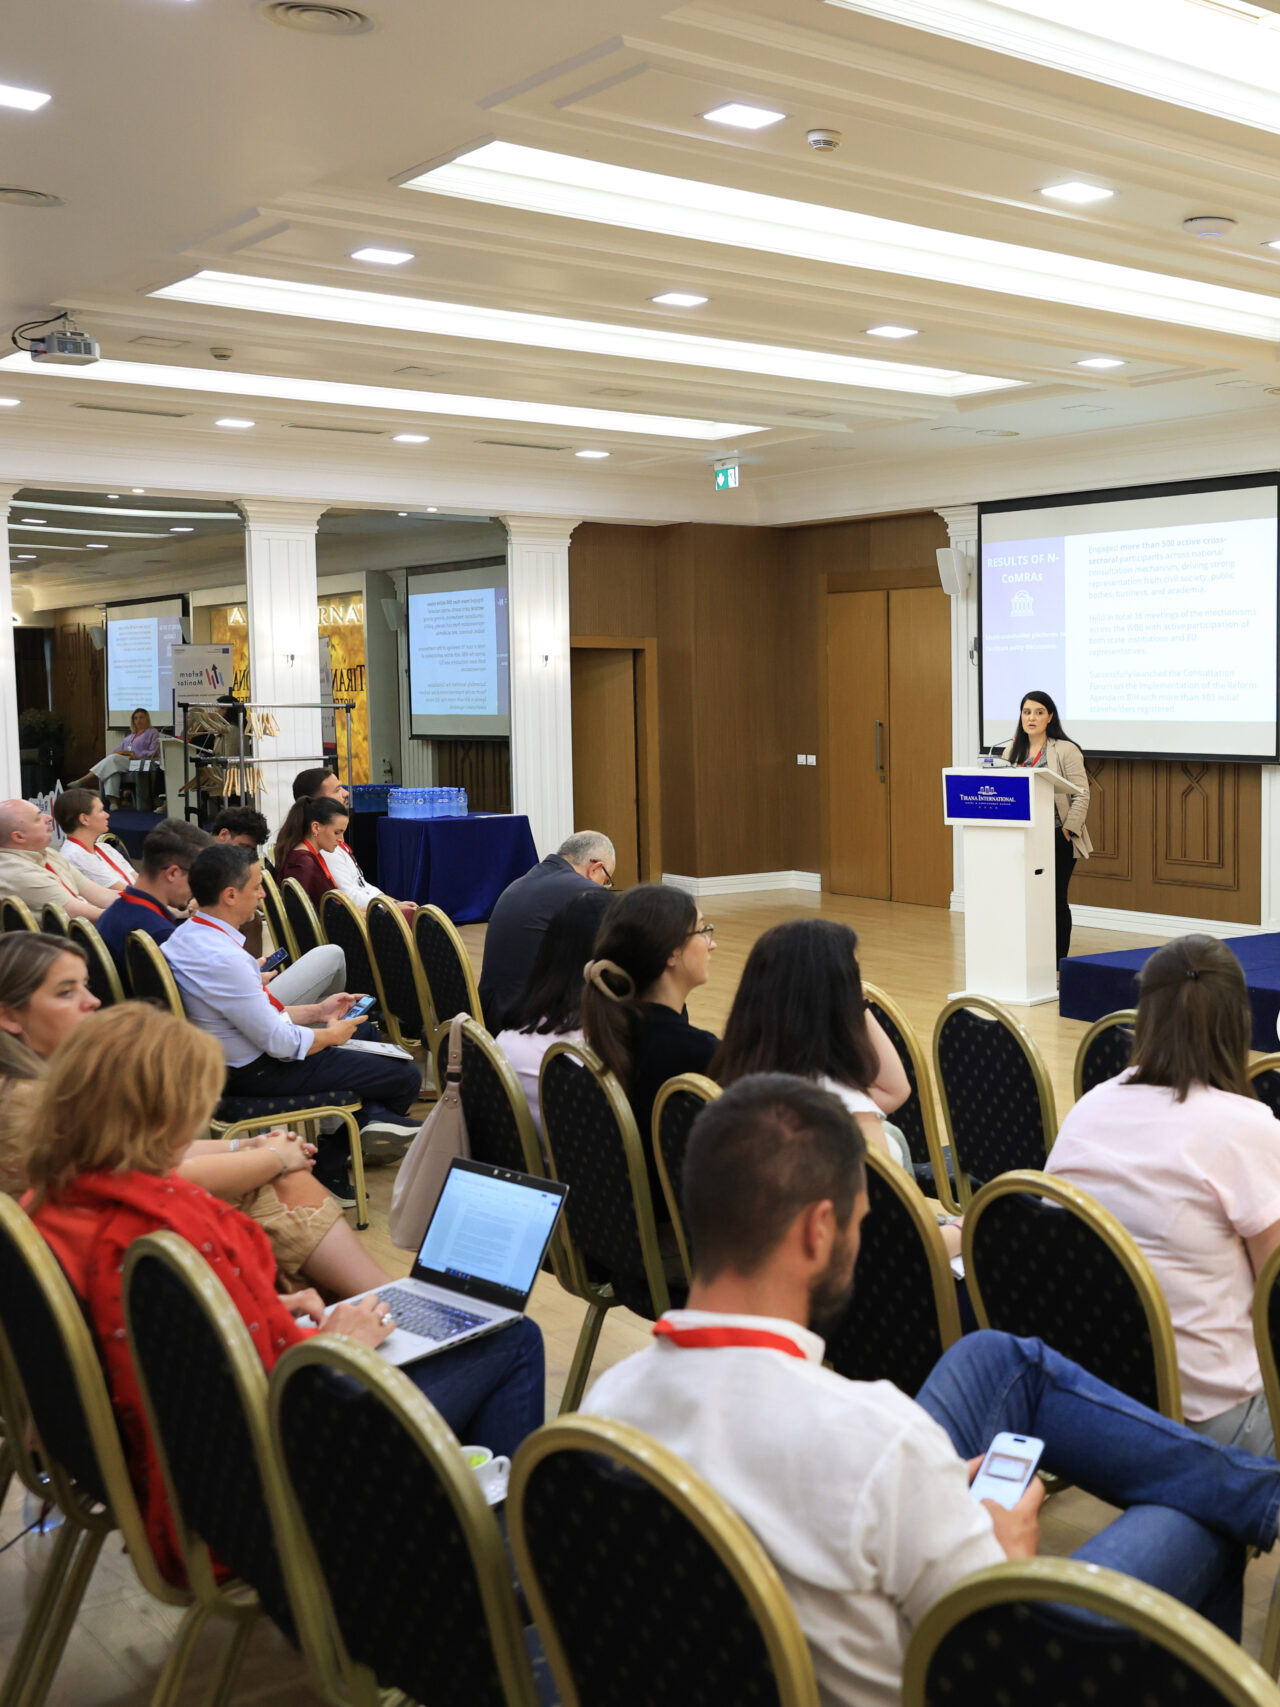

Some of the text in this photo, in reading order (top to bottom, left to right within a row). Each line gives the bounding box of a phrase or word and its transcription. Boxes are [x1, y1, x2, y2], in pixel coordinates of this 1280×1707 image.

[1142, 541, 1160, 549] than
[987, 552, 1060, 568] RESULTS OF N-
[1001, 571, 1044, 584] CoMRAs
